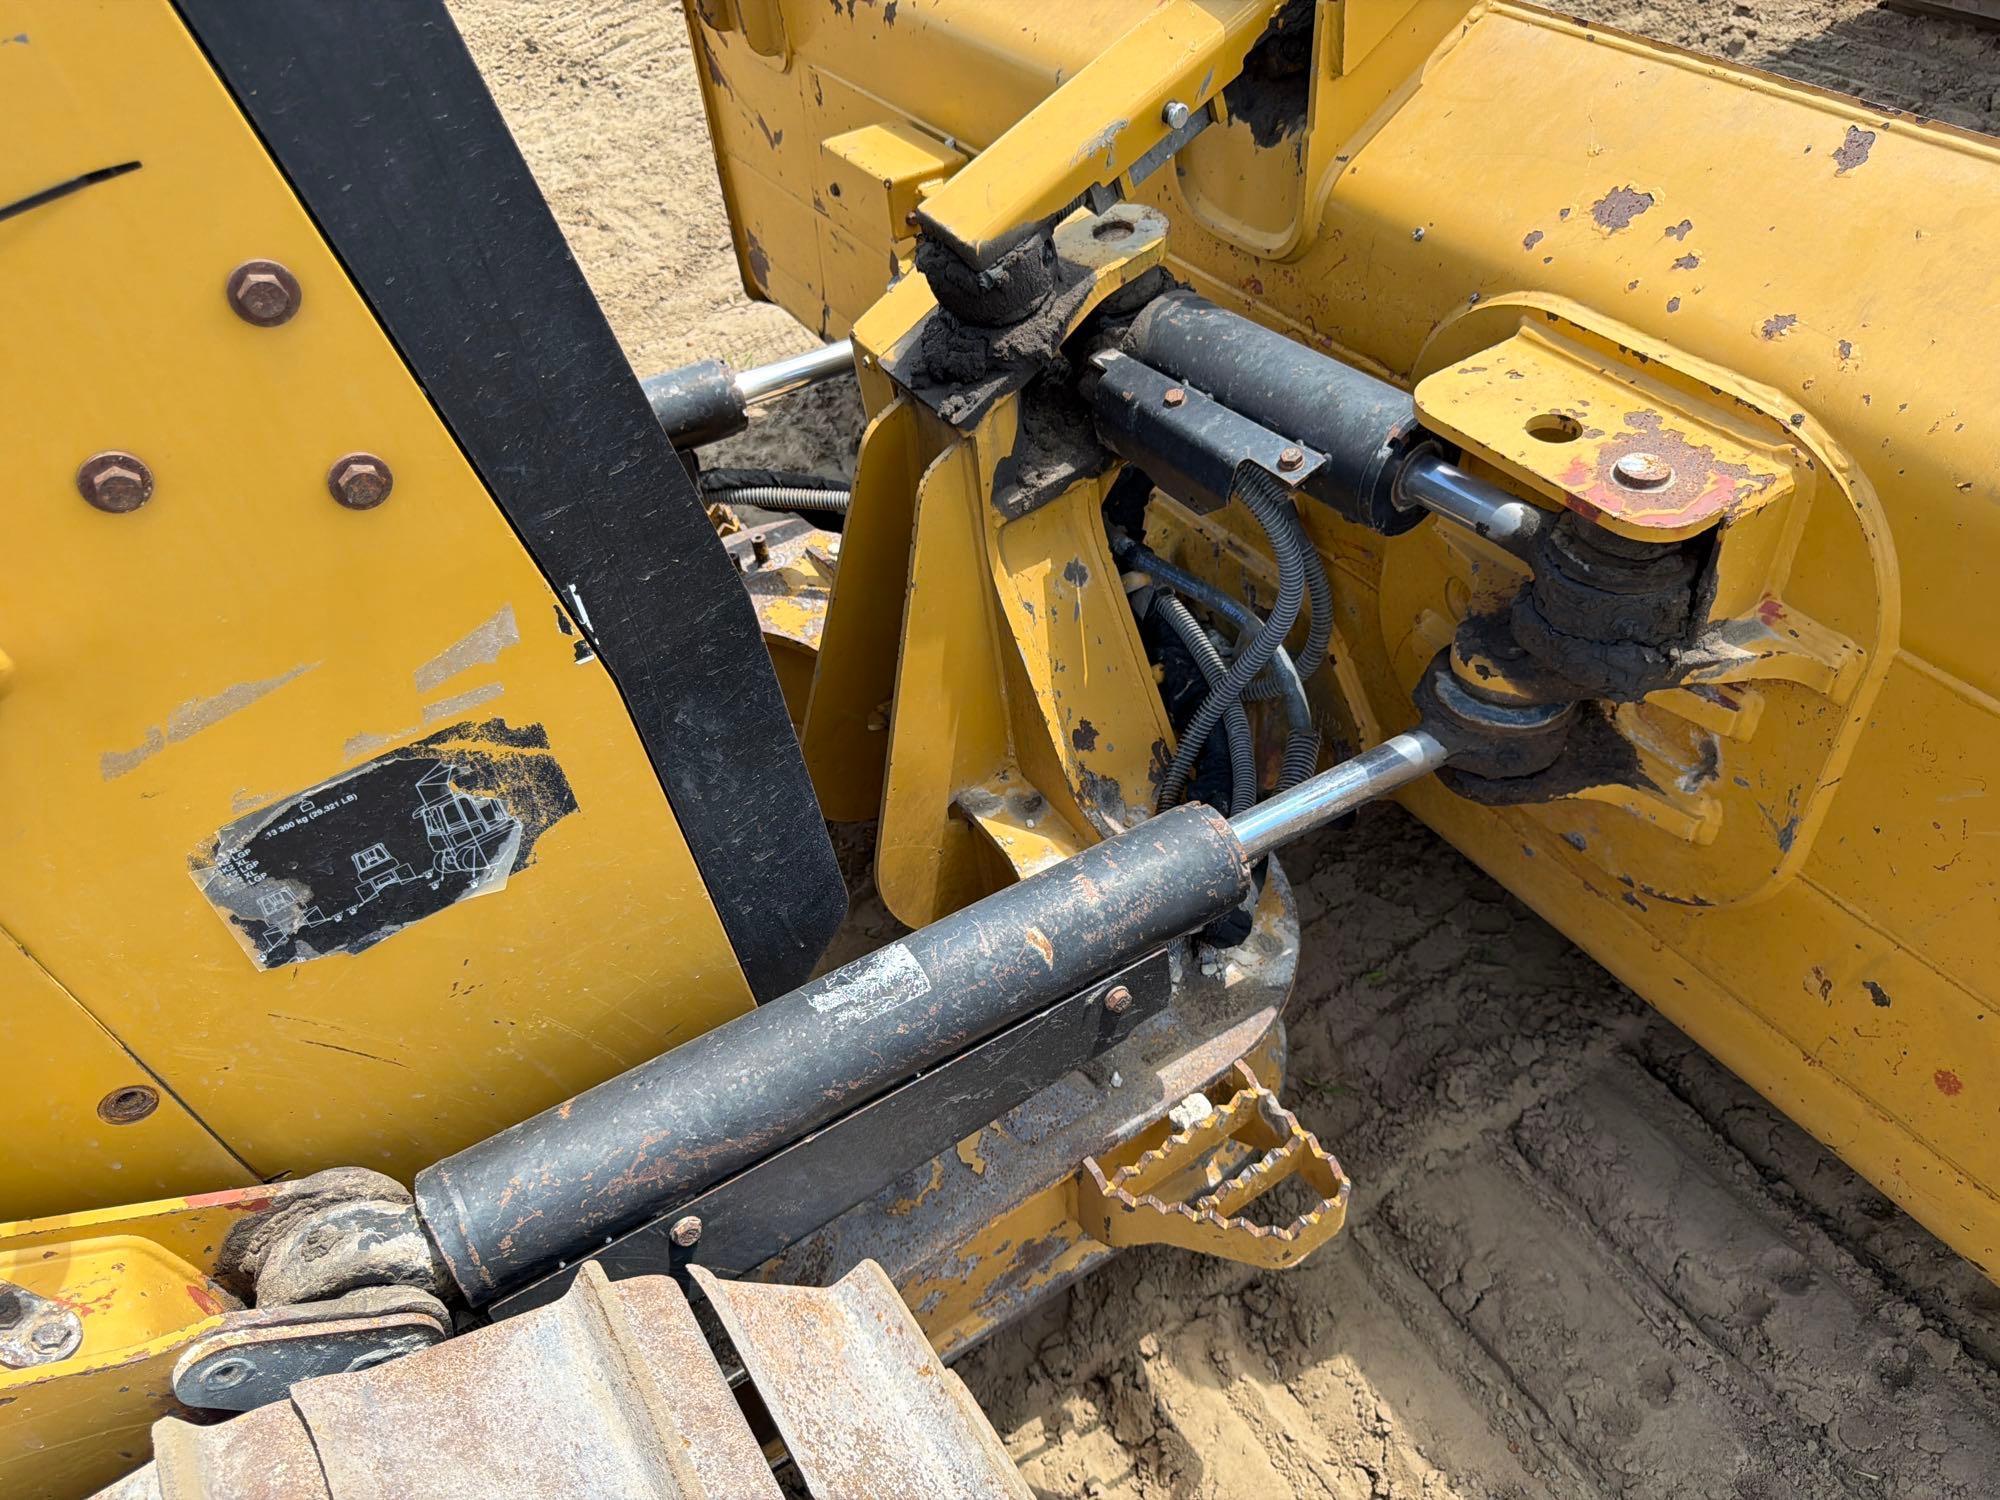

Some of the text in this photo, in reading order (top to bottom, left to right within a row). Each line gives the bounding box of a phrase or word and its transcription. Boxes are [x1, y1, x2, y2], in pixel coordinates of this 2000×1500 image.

[266, 793, 358, 838] 13 300 kg (29,321 LB)
[231, 848, 251, 861] LGP
[235, 858, 249, 867] XL
[239, 860, 259, 873] LGP
[244, 870, 258, 879] XL
[248, 872, 267, 885] LGP
